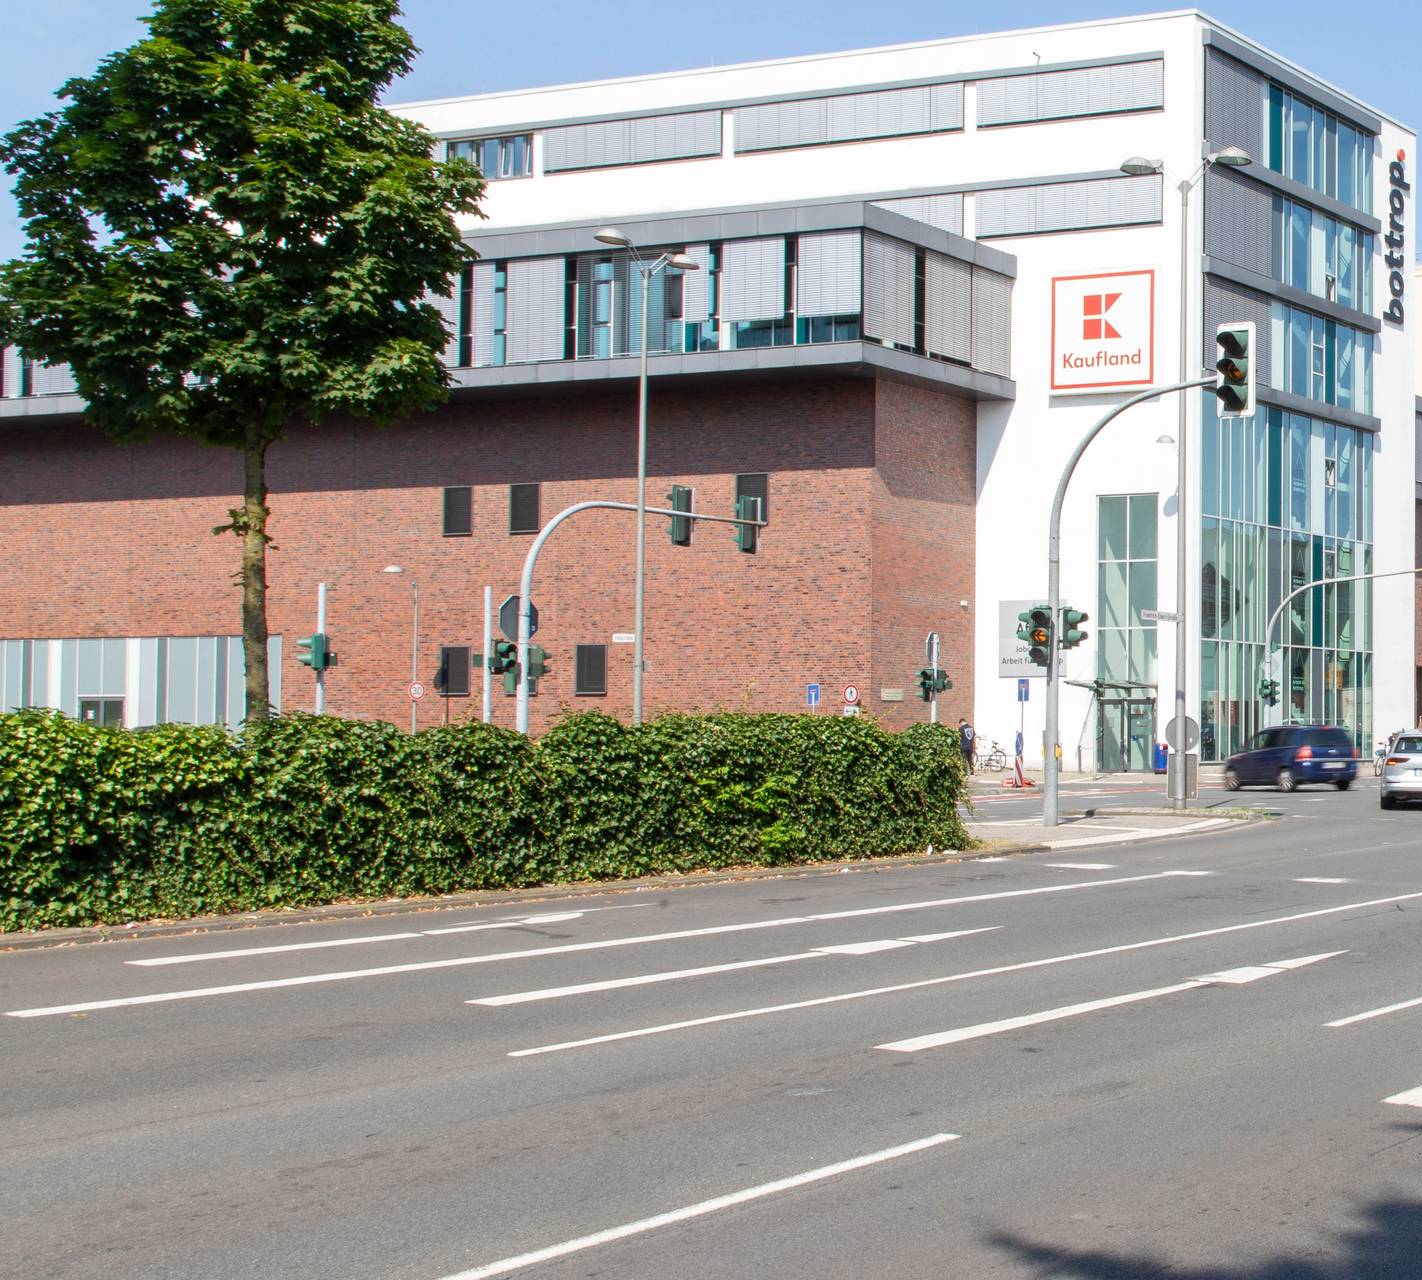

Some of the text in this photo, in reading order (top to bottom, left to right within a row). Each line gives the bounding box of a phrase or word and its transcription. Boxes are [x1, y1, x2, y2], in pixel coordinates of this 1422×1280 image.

[1062, 348, 1141, 369] Kaufland
[1001, 657, 1023, 665] Arbeit
[412, 686, 421, 695] 30
